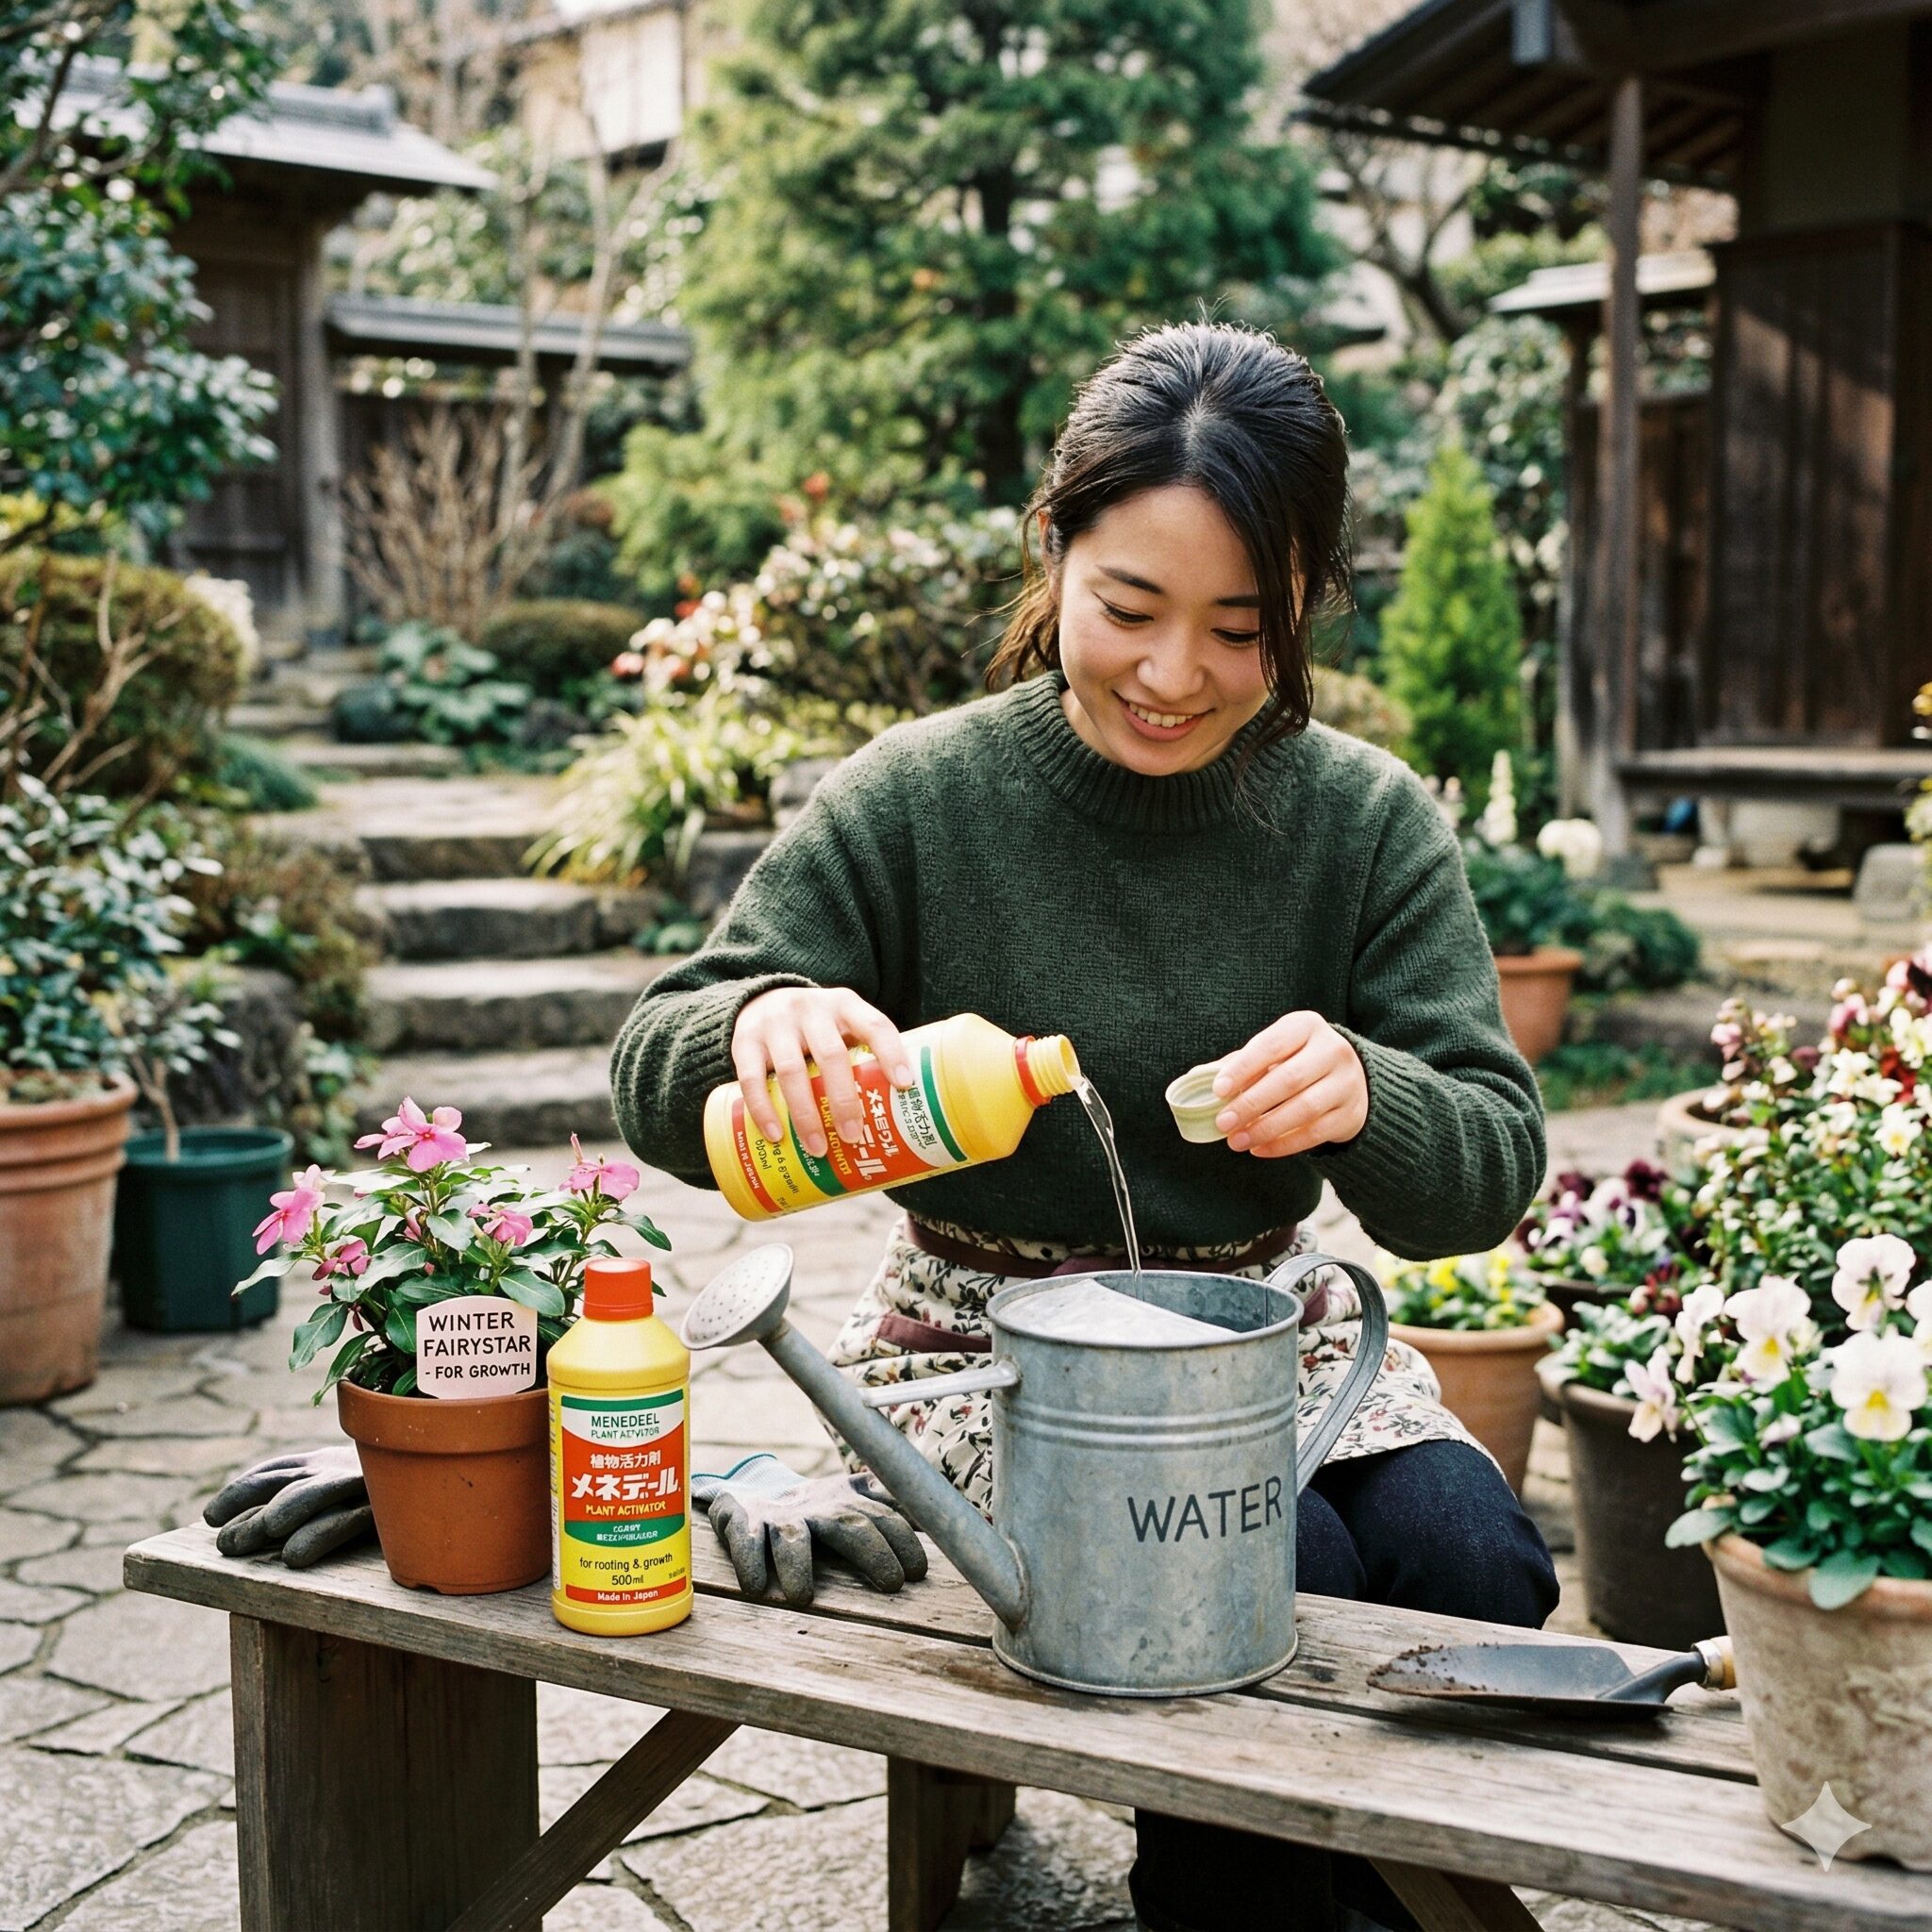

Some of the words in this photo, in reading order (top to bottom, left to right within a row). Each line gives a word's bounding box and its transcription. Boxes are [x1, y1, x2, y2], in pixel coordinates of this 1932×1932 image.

[428, 1311, 515, 1332] WINTER
[424, 1335, 531, 1357] FAIRYSTAR
[435, 1365, 464, 1379] FOR
[469, 1362, 530, 1378] GROWTH
[591, 1412, 660, 1428] MENEDEEL
[571, 1466, 679, 1502] メネデール
[586, 1504, 615, 1517] PLANT
[617, 1500, 666, 1516] ACTIVATOR
[1127, 1475, 1282, 1543] WATER
[579, 1557, 593, 1569] for
[594, 1559, 630, 1573] rooting
[643, 1553, 674, 1571] growth
[597, 1591, 622, 1601] Made
